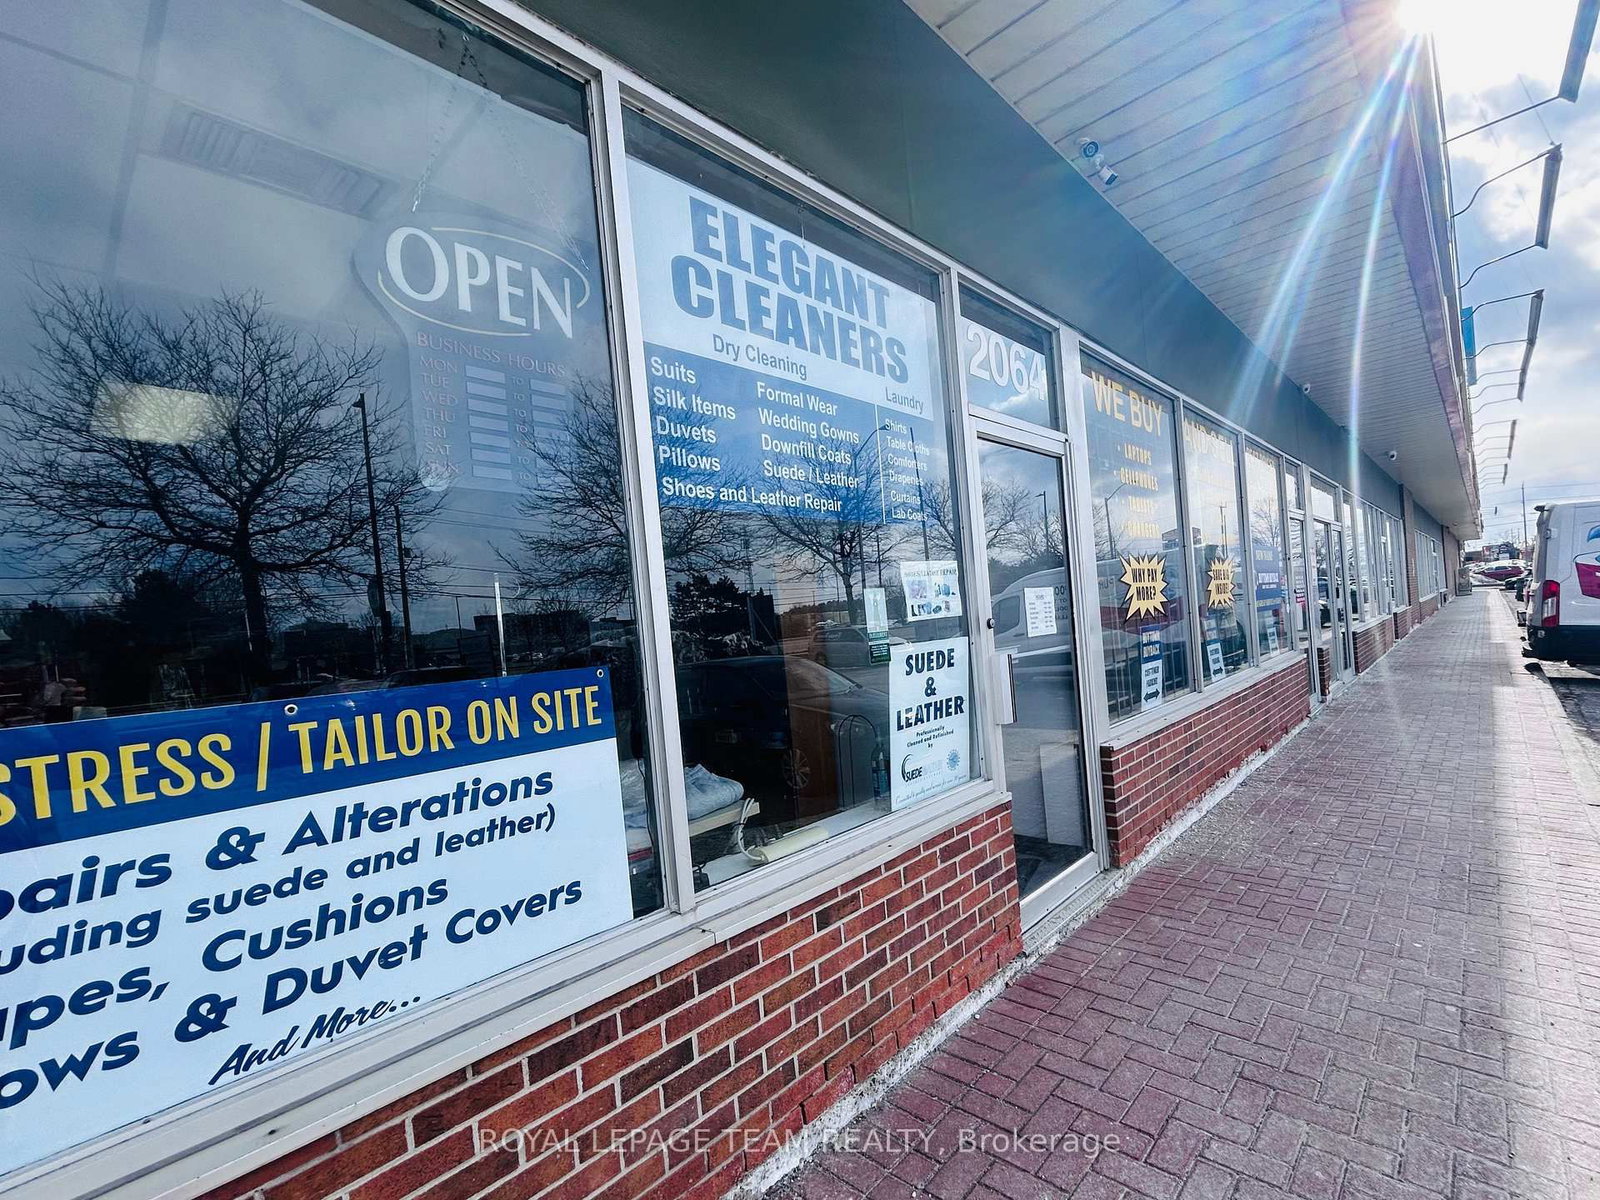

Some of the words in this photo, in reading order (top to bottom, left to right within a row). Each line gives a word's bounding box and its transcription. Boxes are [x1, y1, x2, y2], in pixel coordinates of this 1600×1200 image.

[689, 195, 889, 329] ELEGANT
[385, 227, 573, 339] OPEN
[671, 255, 909, 384] CLEANERS
[417, 331, 501, 363] BUSINESS
[508, 353, 566, 377] HOURS
[712, 333, 741, 362] Dry
[745, 344, 807, 380] Cleaning
[967, 323, 1045, 400] 2064
[420, 356, 458, 373] MON
[511, 376, 524, 385] TO
[651, 357, 696, 384] Suits
[421, 373, 450, 388] TUE
[513, 392, 525, 401] TO
[757, 381, 804, 408] Formal
[807, 394, 839, 416] Wear
[885, 387, 924, 415] Laundry
[421, 390, 458, 406] WED
[514, 408, 527, 418] TO
[653, 386, 687, 410] Silk
[692, 394, 736, 420] Items
[1091, 371, 1126, 422] WE
[1129, 389, 1163, 437] BUY
[423, 407, 456, 422] THU
[516, 424, 528, 433] TO
[424, 425, 447, 439] FRI
[656, 415, 716, 443] Duvets
[758, 408, 817, 438] Wedding
[821, 422, 859, 443] Gowns
[885, 418, 907, 434] Shirts
[426, 441, 452, 456] SAT
[658, 445, 720, 471] Pillows
[761, 434, 815, 458] Downfill
[819, 445, 851, 465] Coats
[886, 436, 906, 451] Table
[908, 442, 930, 456] Coths
[763, 460, 806, 480] Suede
[817, 468, 858, 488] Leather
[662, 476, 715, 499] Shoes
[719, 486, 747, 502] and
[751, 487, 801, 508] Leather
[804, 494, 842, 512] Repair
[892, 507, 907, 520] Lab
[1131, 568, 1146, 583] WHY
[1147, 568, 1158, 583] PAY
[1136, 586, 1157, 600] MORE?
[905, 648, 955, 676] SUEDE
[925, 676, 937, 697] &
[896, 695, 965, 732] LEATHER
[256, 723, 271, 791] /
[288, 706, 455, 774] TAILOR
[467, 697, 519, 745] ON
[533, 685, 602, 733] SITE
[0, 855, 173, 923] airs
[205, 825, 266, 871] &
[282, 771, 554, 856] Alterations
[185, 868, 328, 924] suede
[346, 838, 420, 881] and
[435, 803, 557, 858] leather)
[0, 966, 170, 1051] pes,
[202, 879, 449, 973] Cushions
[174, 993, 239, 1043] &
[262, 924, 429, 1016] Duvet
[444, 880, 584, 944] Covers
[208, 1024, 304, 1087] And
[300, 997, 423, 1050] More...
